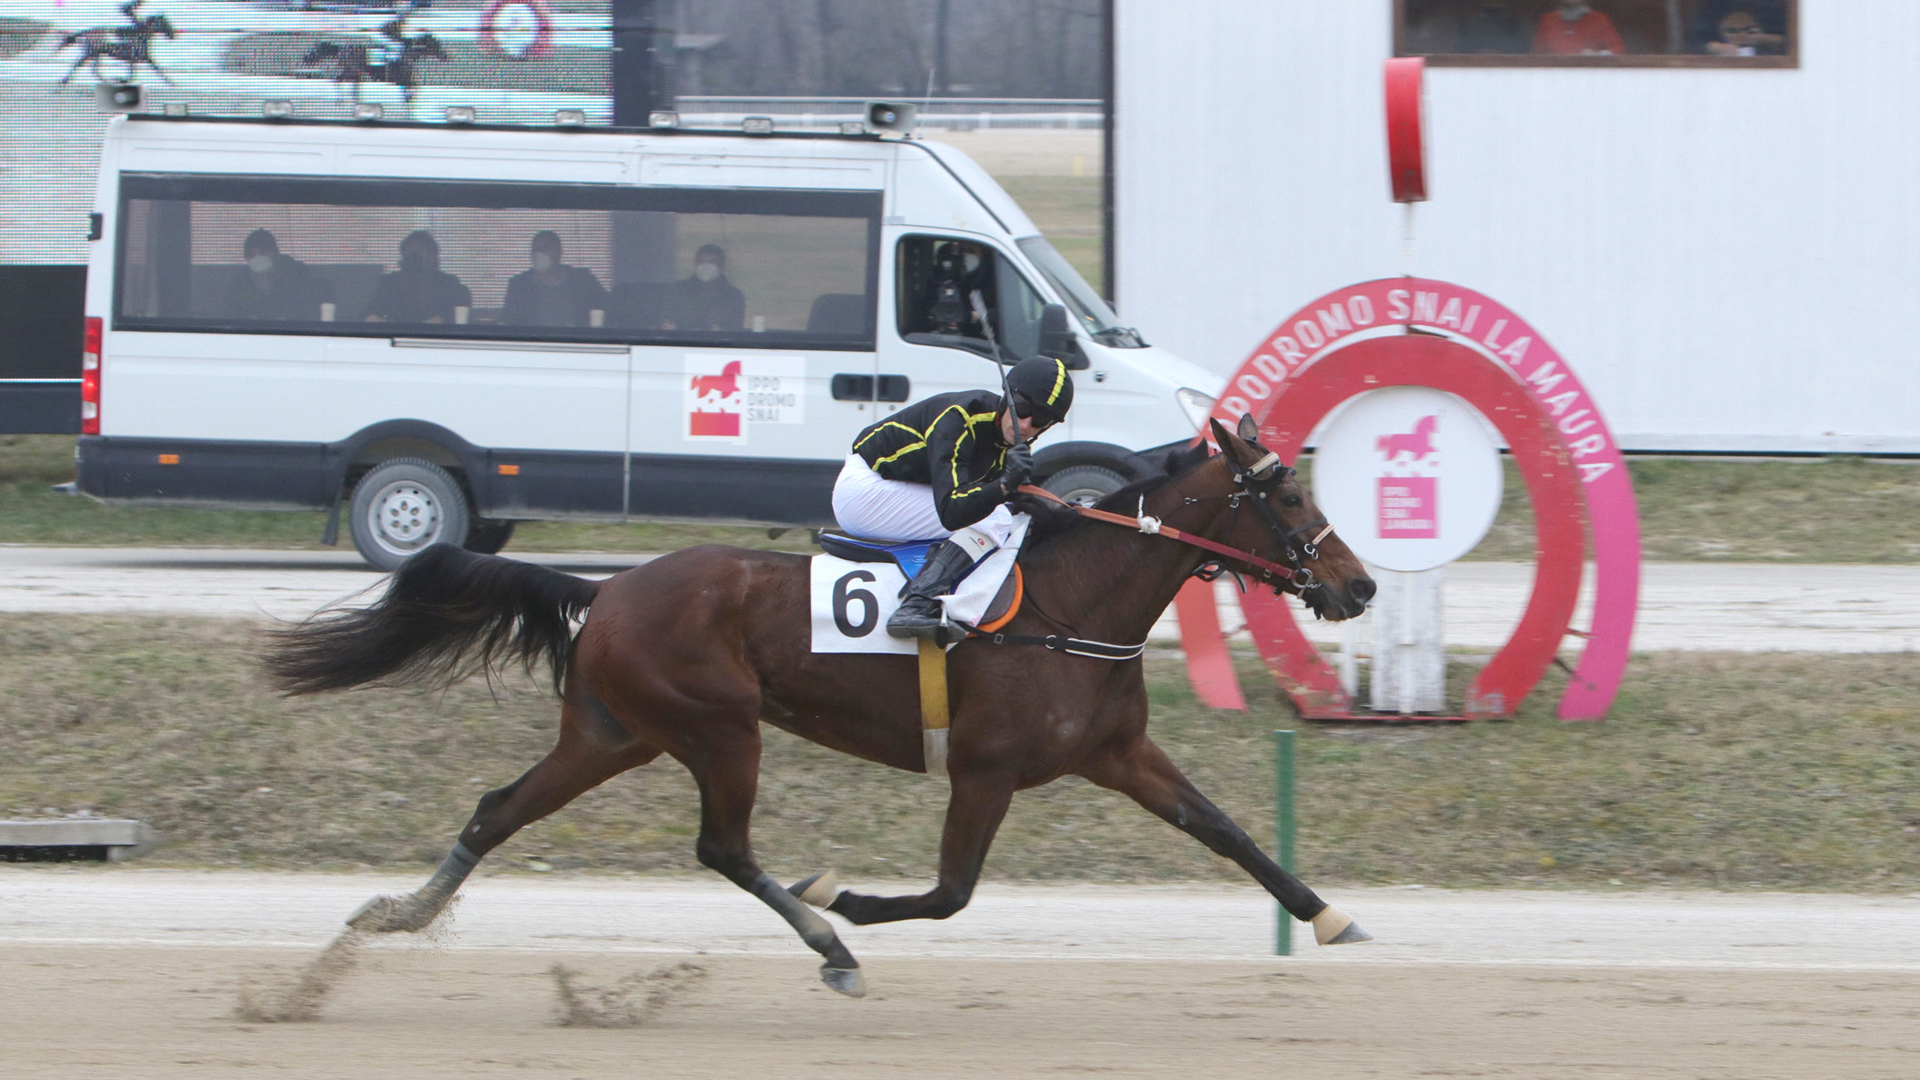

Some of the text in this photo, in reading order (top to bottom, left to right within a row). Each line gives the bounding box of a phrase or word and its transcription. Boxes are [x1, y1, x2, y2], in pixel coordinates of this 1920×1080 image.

[748, 376, 780, 391] IPPO
[1387, 289, 1482, 333] SNAI
[1483, 319, 1532, 365] LA
[1526, 361, 1615, 482] MAURA
[747, 392, 796, 407] DROMO
[747, 408, 780, 421] SNAI
[832, 570, 879, 638] 6
